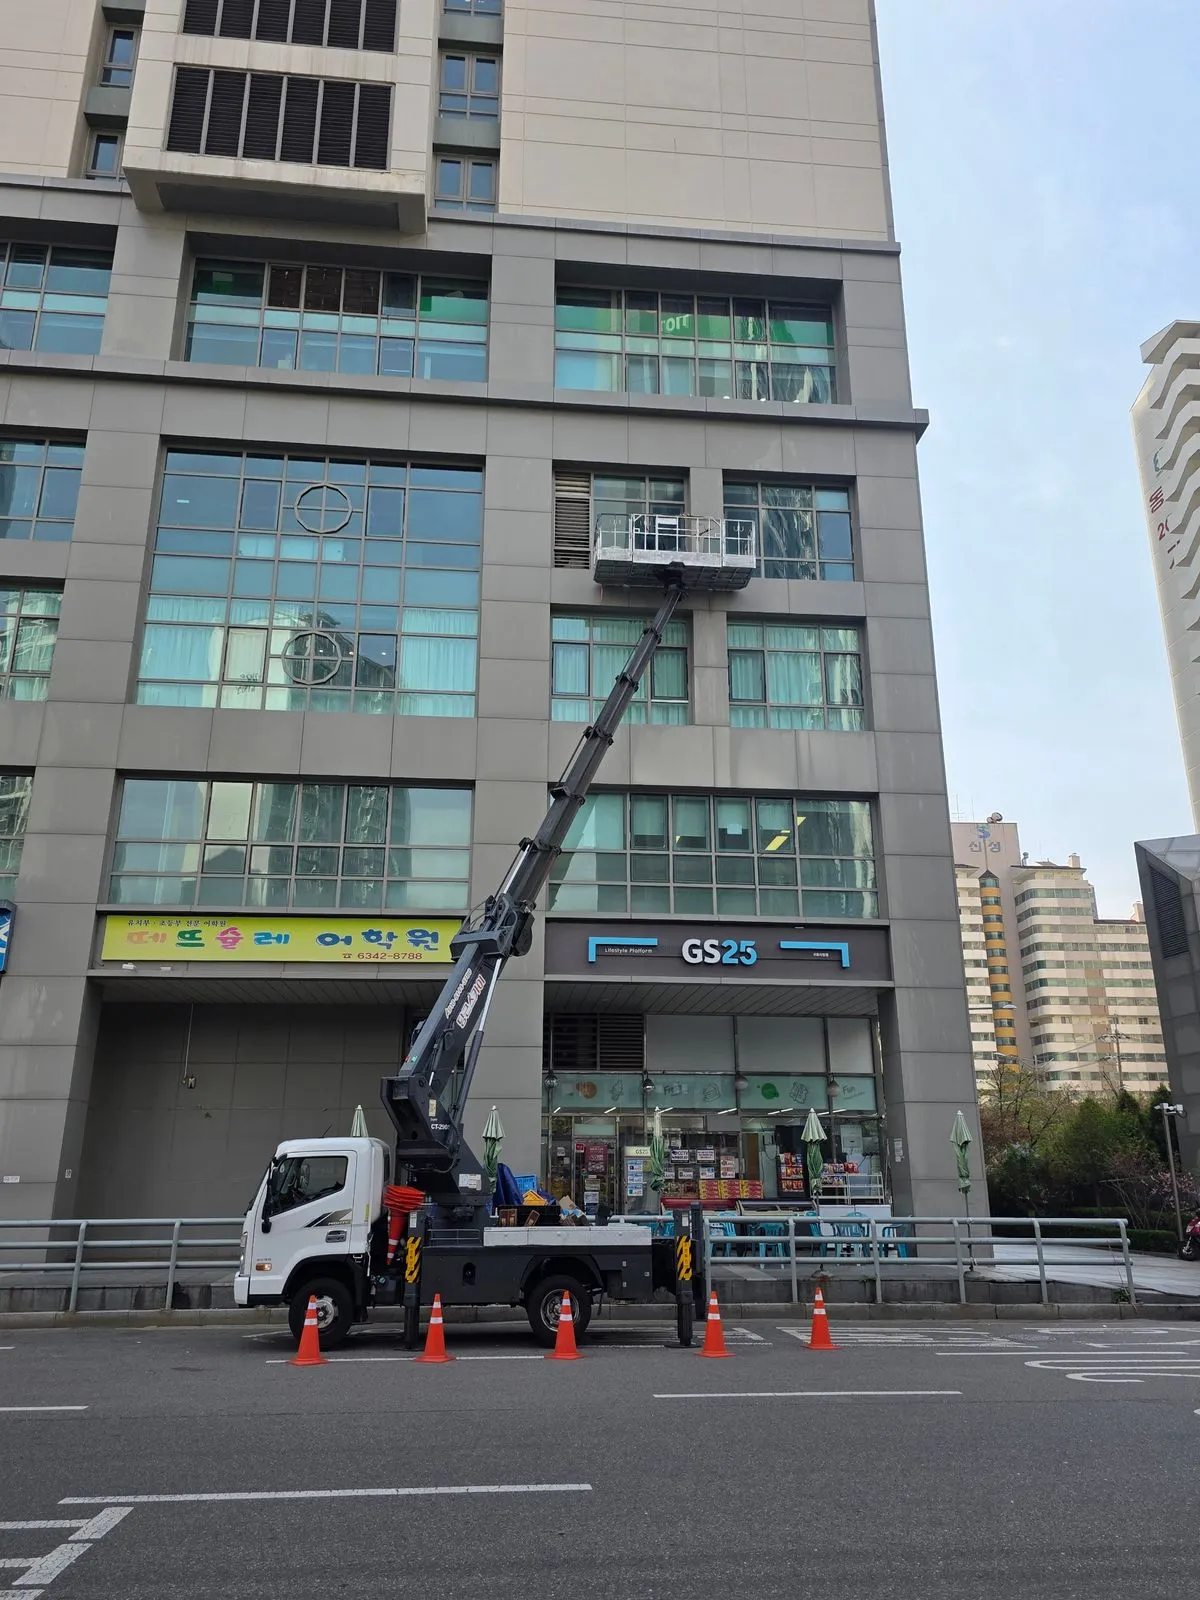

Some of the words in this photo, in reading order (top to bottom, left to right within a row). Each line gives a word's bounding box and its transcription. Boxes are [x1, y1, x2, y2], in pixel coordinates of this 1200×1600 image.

[315, 928, 440, 951] 어학원
[357, 952, 423, 960] 6342-8788
[682, 938, 758, 965] GS25
